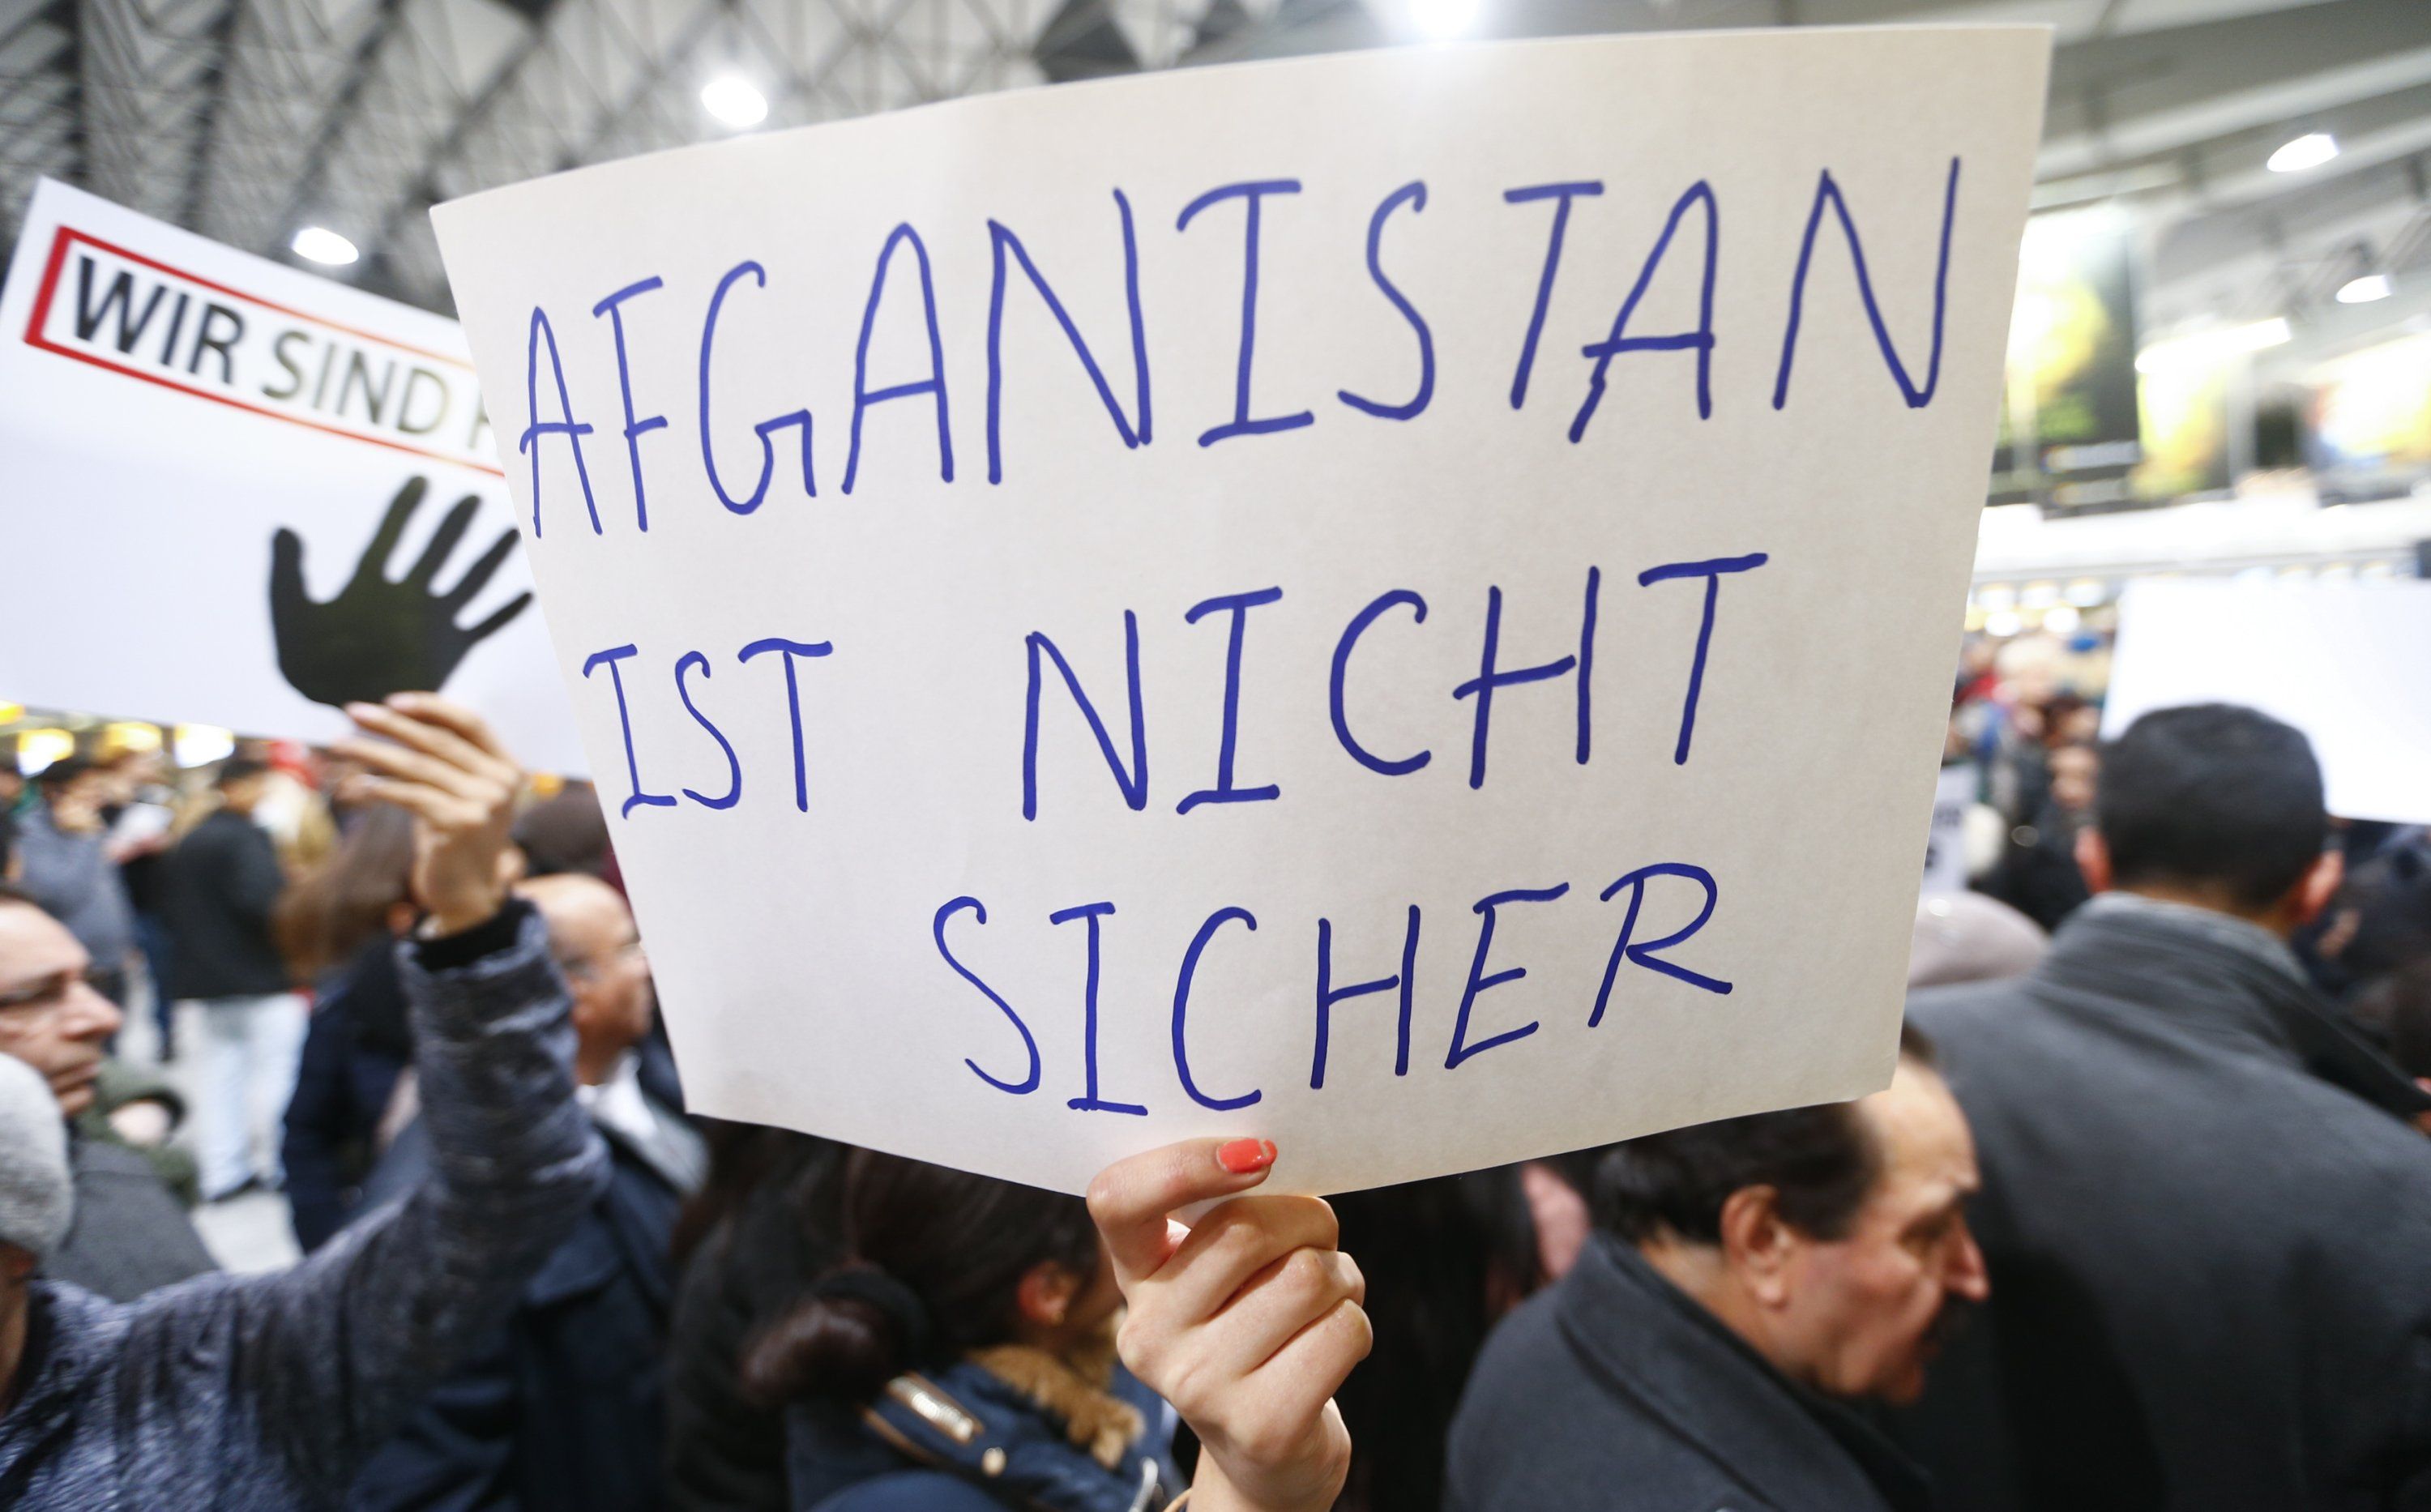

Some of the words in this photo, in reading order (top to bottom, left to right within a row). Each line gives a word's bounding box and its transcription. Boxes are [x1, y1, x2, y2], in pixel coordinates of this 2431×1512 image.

[73, 254, 246, 385] WIR
[260, 329, 450, 435] SIND
[519, 156, 1960, 538] AFGANISTAN
[583, 637, 834, 818] IST
[1022, 553, 1768, 822] NICHT
[933, 862, 1732, 1117] SICHER
